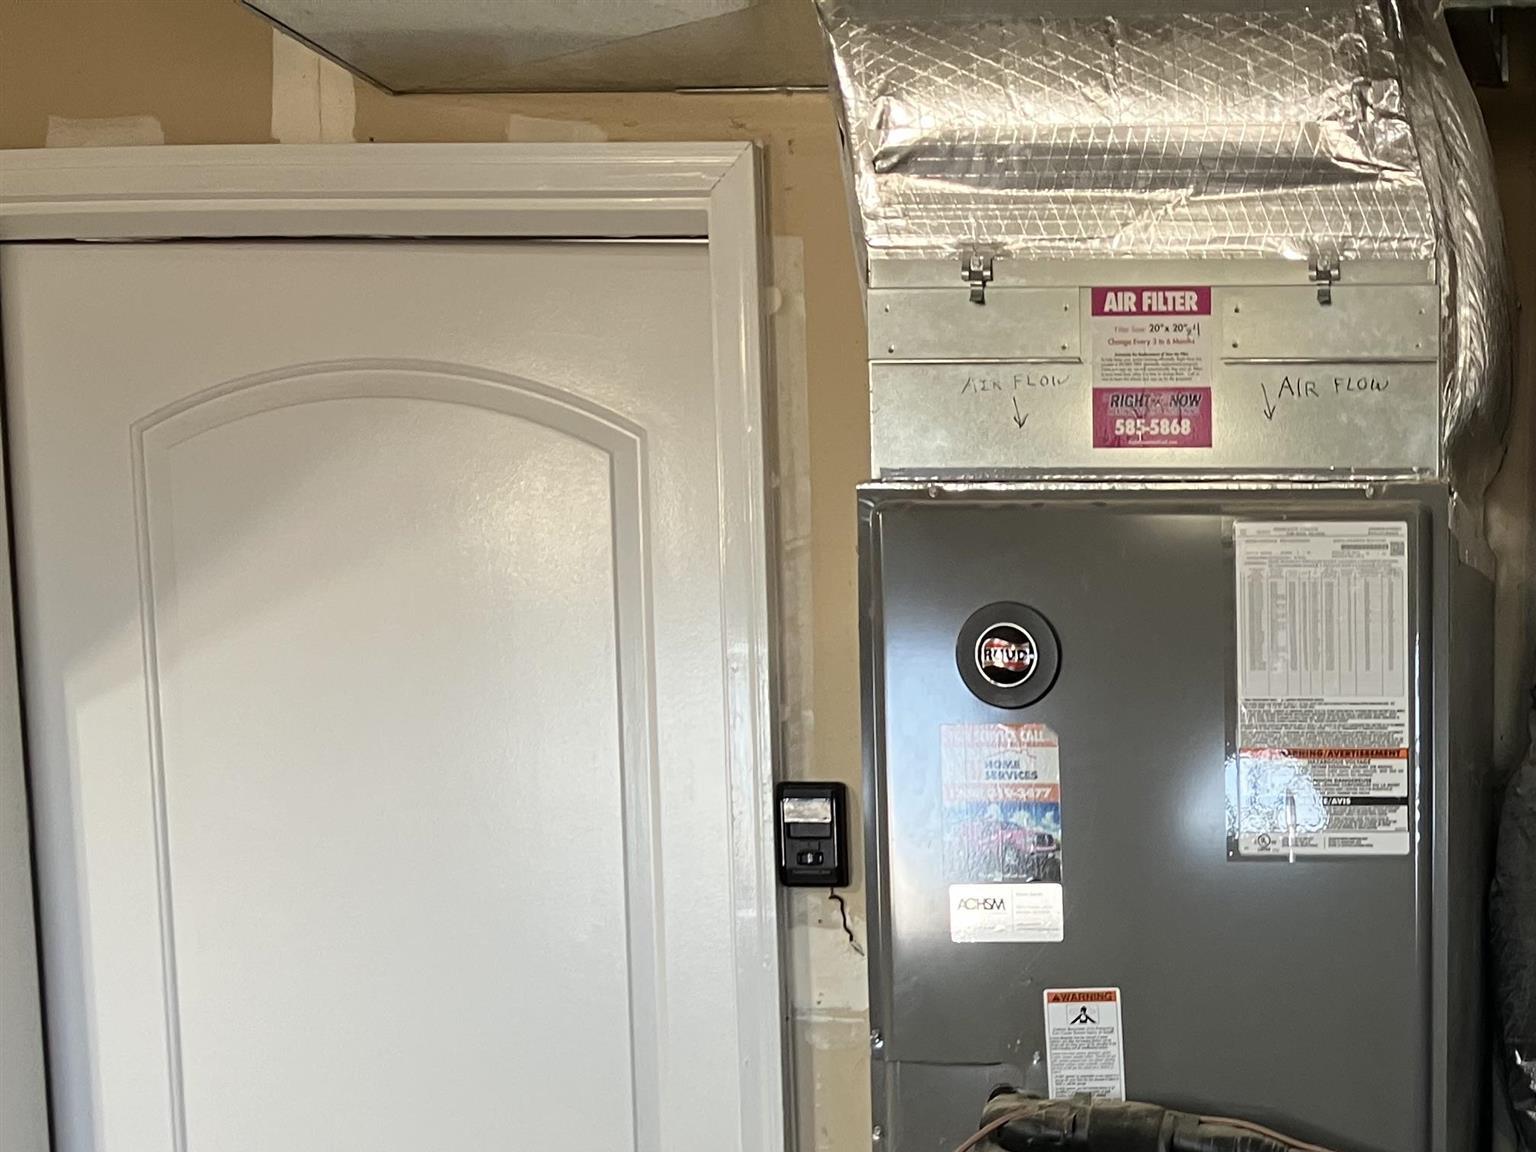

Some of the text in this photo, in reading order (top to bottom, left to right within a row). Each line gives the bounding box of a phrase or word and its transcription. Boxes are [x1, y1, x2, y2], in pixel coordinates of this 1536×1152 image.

[1103, 290, 1198, 312] AIR FILTER
[961, 374, 1070, 394] AIR FLOW
[1278, 376, 1389, 398] AIR FLOW
[1111, 393, 1202, 408] RIGHT NOW
[1115, 418, 1192, 436] 585-5868
[1057, 992, 1113, 1002] WARNING
